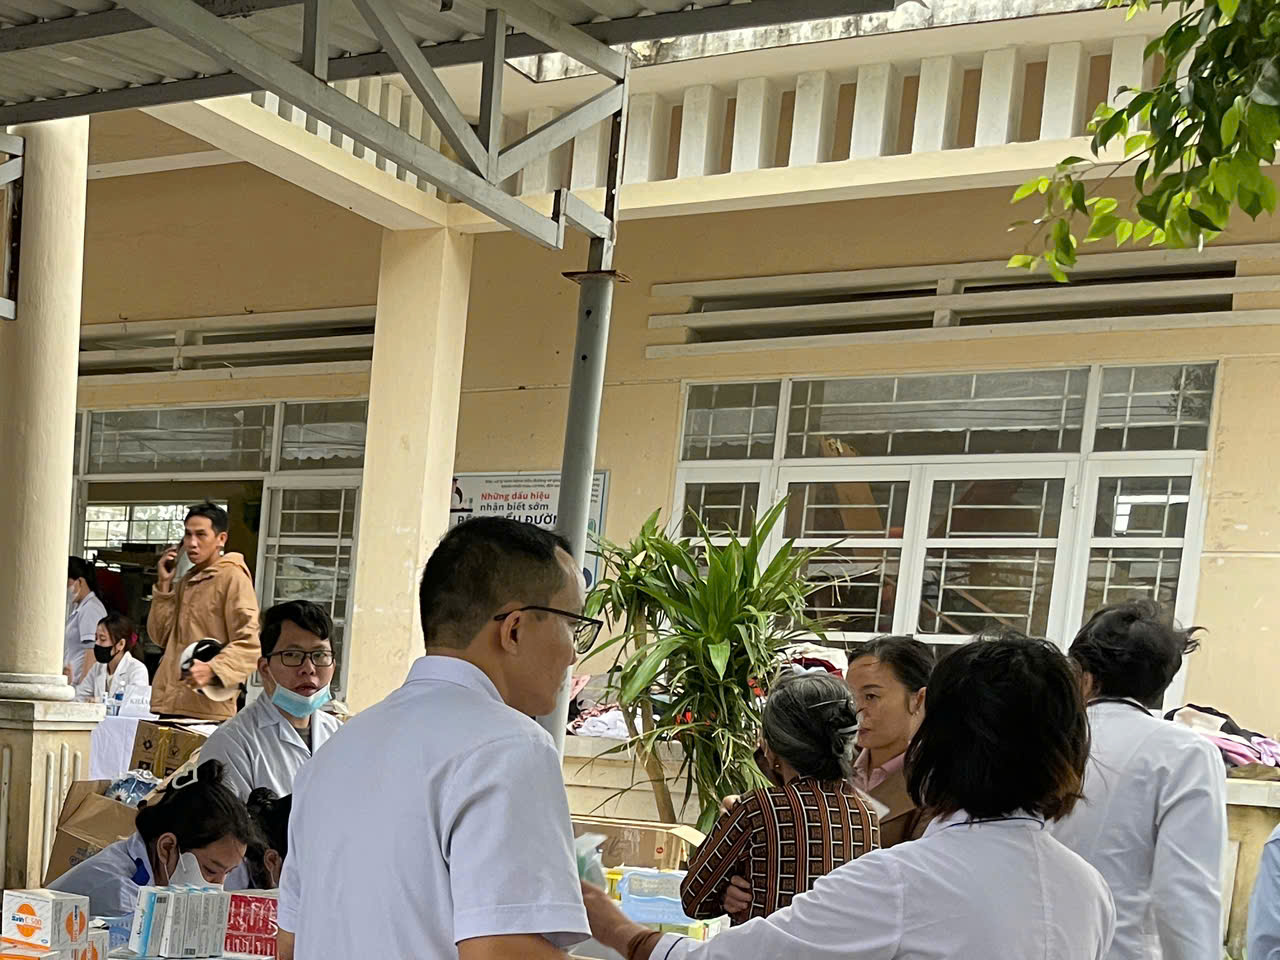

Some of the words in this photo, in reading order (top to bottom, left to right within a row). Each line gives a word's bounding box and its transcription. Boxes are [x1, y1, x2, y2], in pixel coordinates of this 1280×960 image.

[481, 491, 509, 502] Những
[512, 491, 527, 500] dấu
[530, 491, 550, 501] hiệu
[480, 502, 504, 513] nhận
[507, 502, 525, 511] biết
[528, 502, 549, 511] sớm
